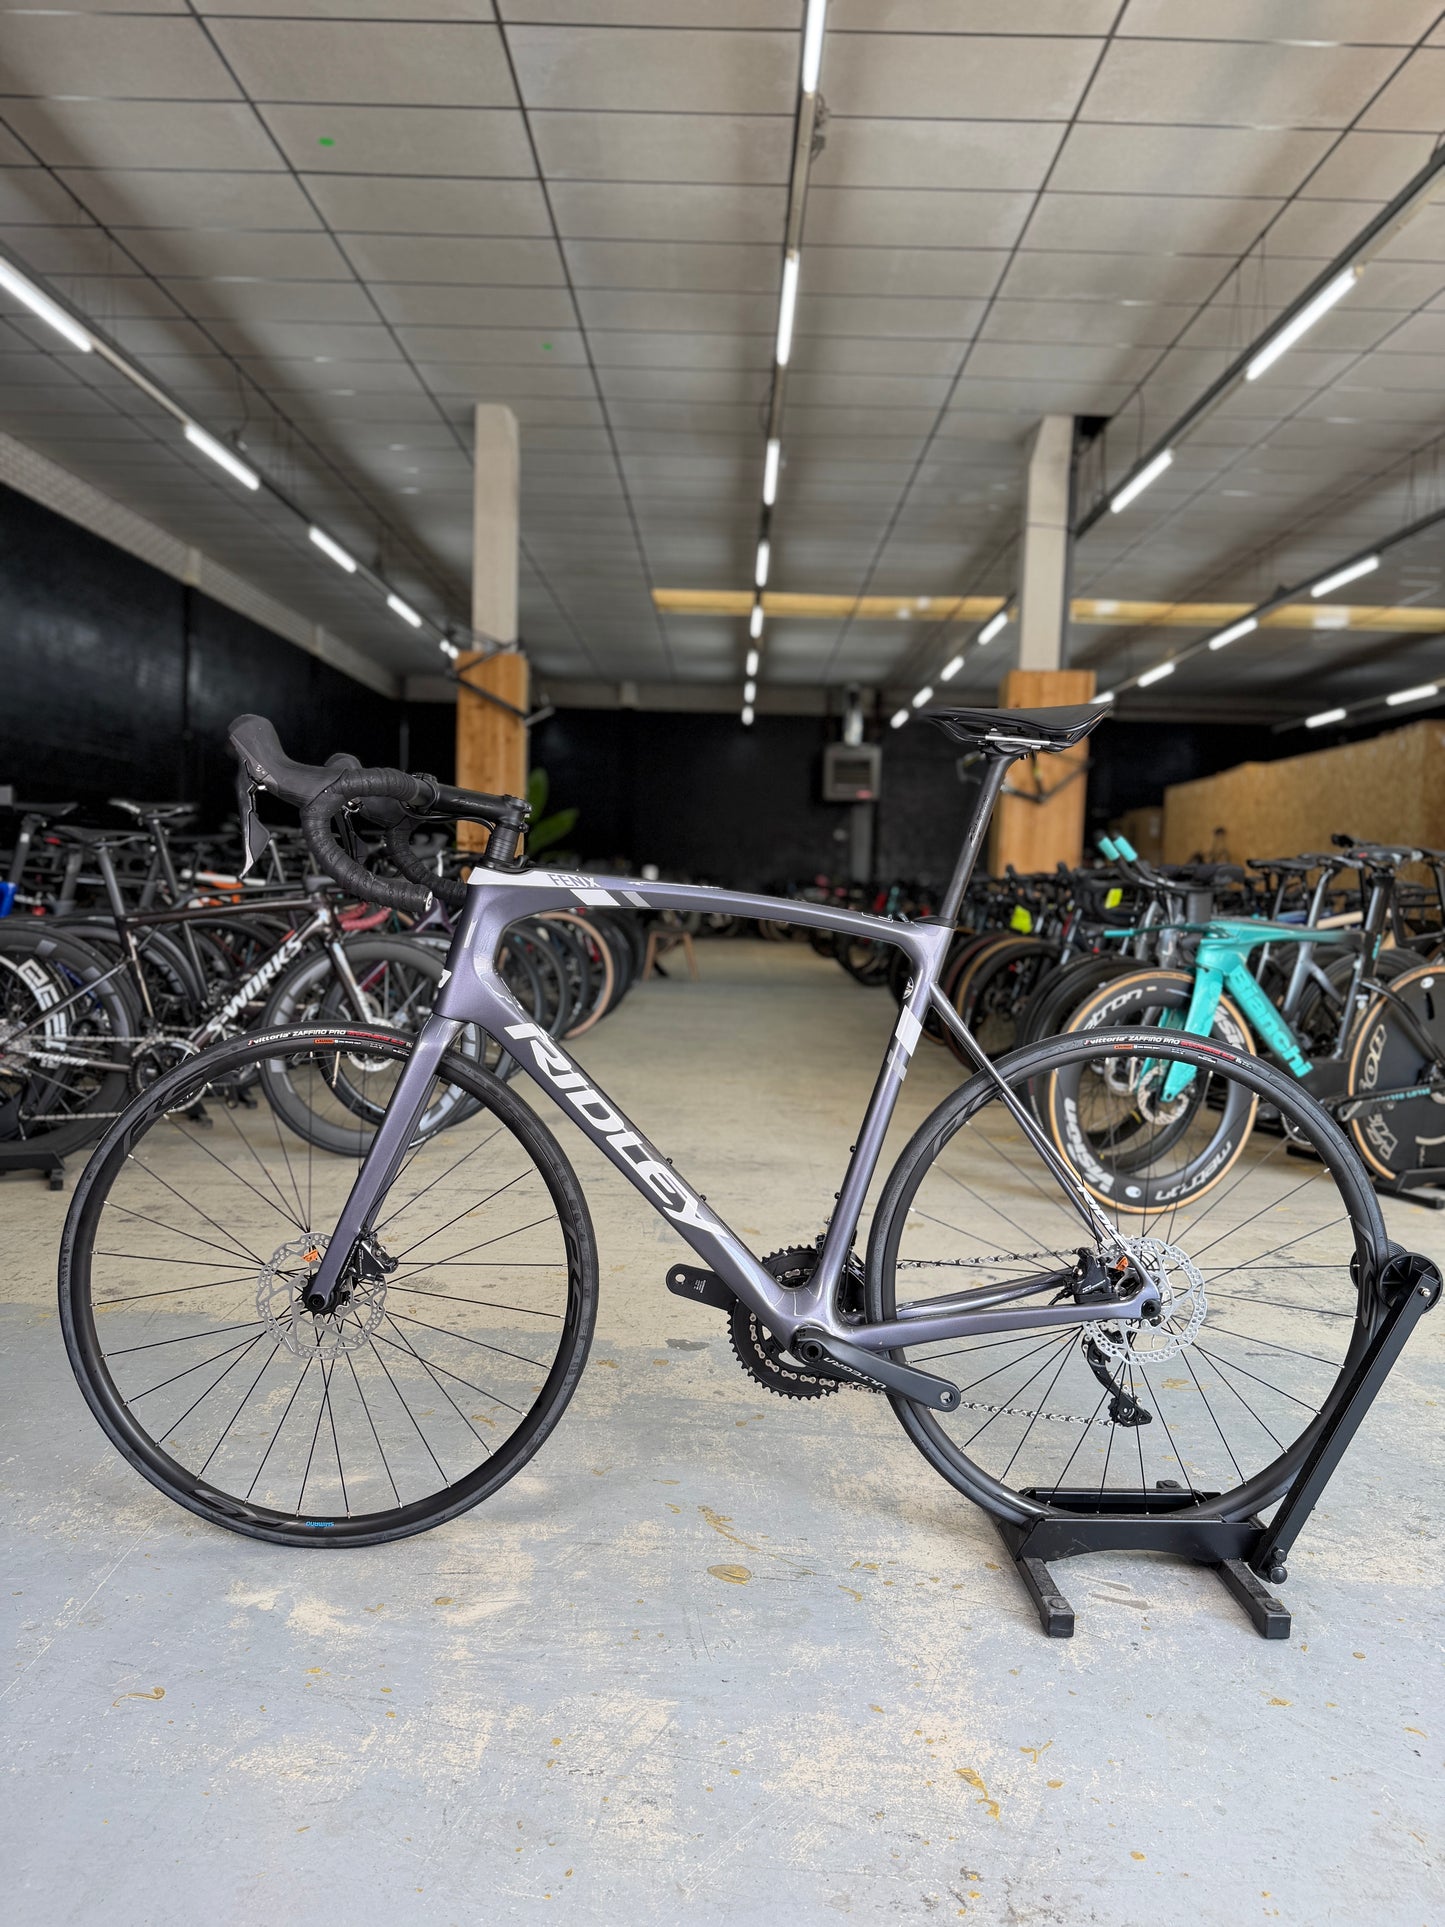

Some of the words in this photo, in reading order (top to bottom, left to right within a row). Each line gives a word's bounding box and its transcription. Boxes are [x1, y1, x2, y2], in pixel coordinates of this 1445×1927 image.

[547, 873, 599, 888] FENIX
[292, 1029, 327, 1037] ZAFFIRO
[1229, 965, 1313, 1077] Bianchi
[1163, 1037, 1180, 1045] PRO
[504, 1022, 730, 1239] RIDLEY
[1155, 1140, 1233, 1201] metron
